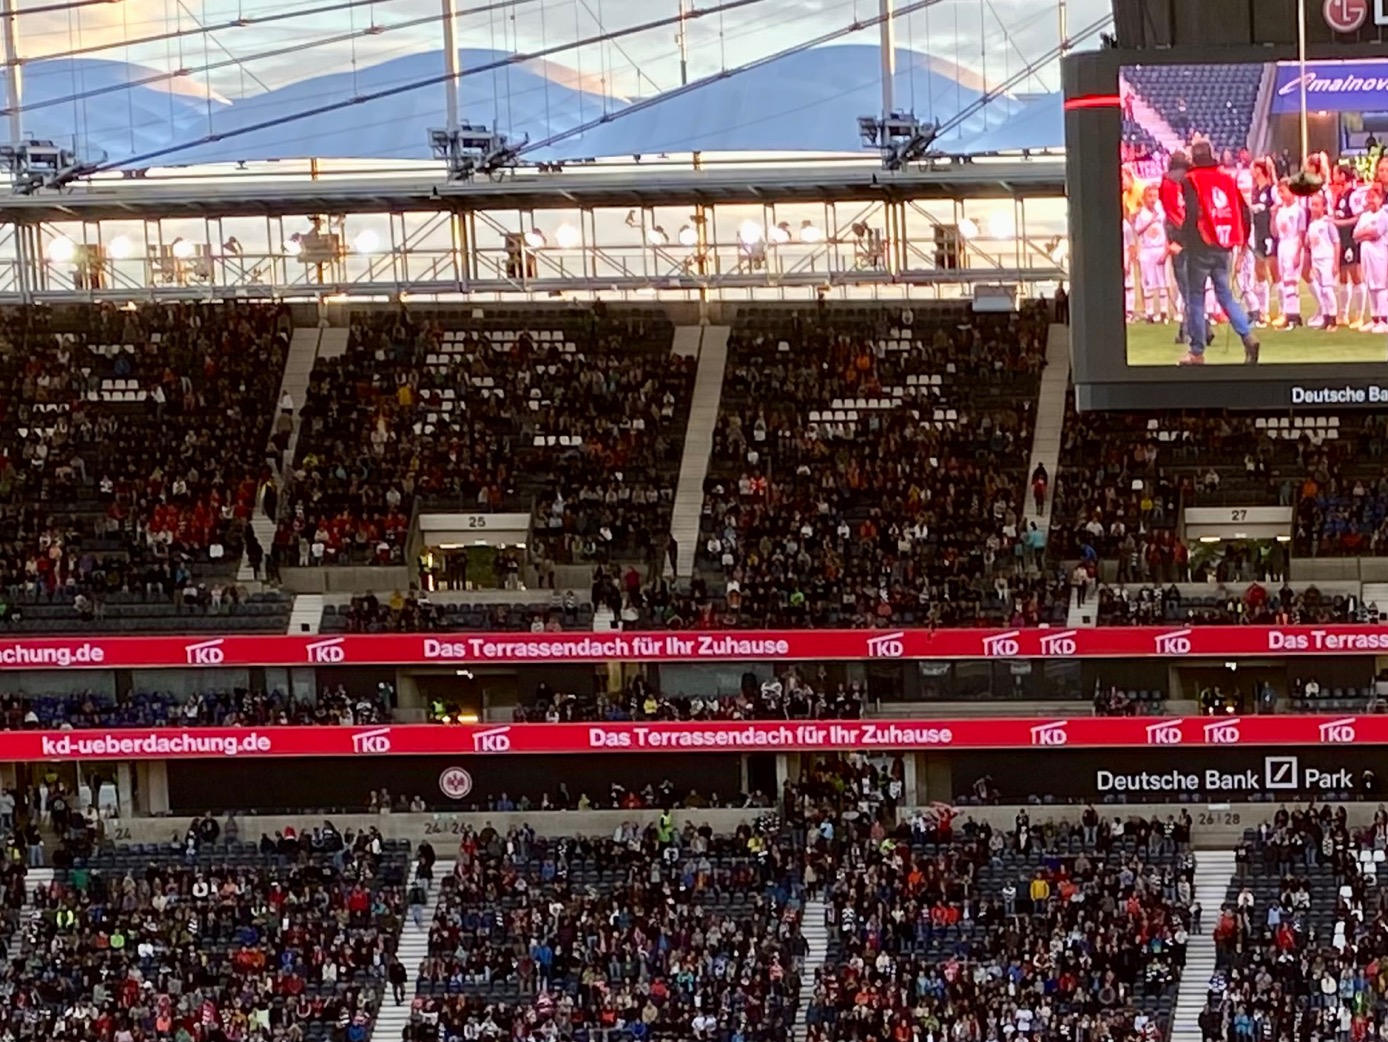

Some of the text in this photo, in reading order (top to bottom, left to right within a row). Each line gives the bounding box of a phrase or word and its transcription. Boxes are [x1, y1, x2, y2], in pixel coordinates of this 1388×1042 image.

[1292, 387, 1365, 402] Deutsche
[469, 517, 485, 527] 25
[1232, 510, 1246, 520] 27
[424, 637, 788, 657] Das Terrassendach für Ihr Zuhause
[1268, 632, 1308, 650] Das
[590, 725, 952, 746] Das Terrassendach für Ihr Zuhause
[43, 733, 271, 755] kd-ueberdachung.de
[1098, 769, 1352, 790] Deutsche Bank Park
[1199, 813, 1240, 825] 26 28
[115, 828, 131, 841] 24
